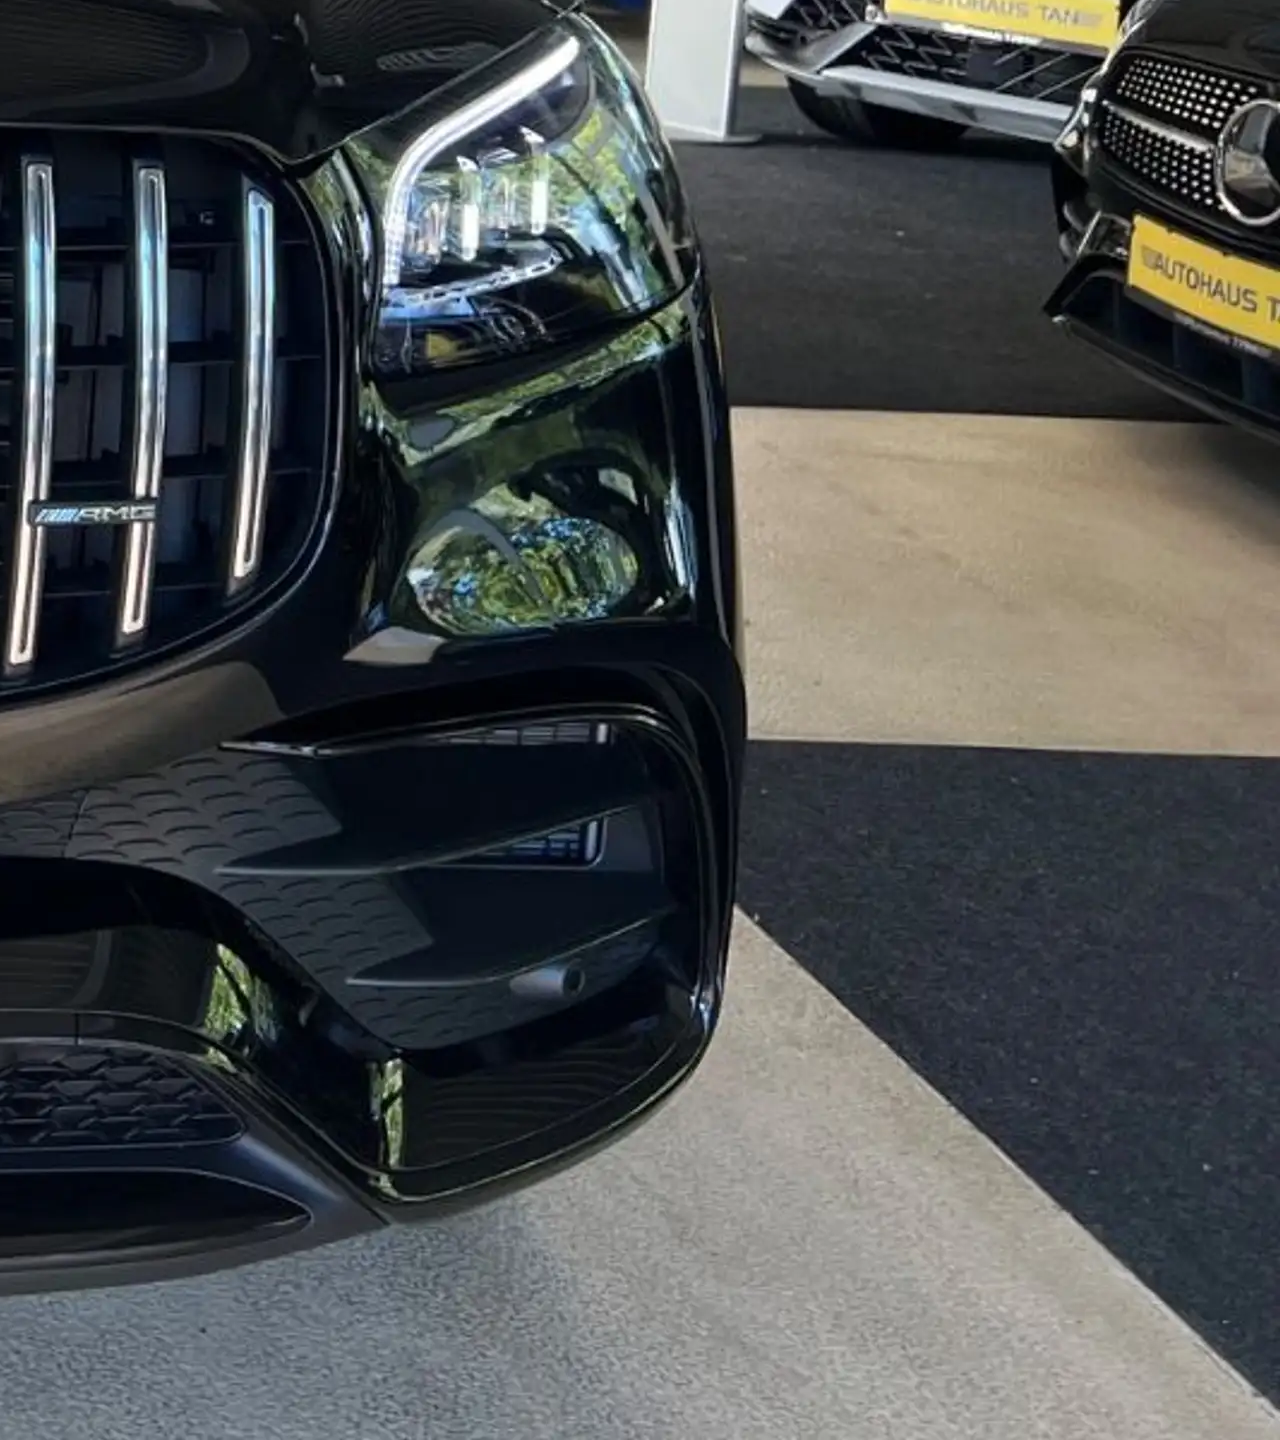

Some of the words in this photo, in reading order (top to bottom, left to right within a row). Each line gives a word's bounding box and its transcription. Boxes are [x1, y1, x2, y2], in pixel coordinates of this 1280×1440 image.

[1037, 6, 1080, 26] TAN
[1153, 253, 1258, 313] AUTOHAUS
[75, 504, 156, 523] AMG
